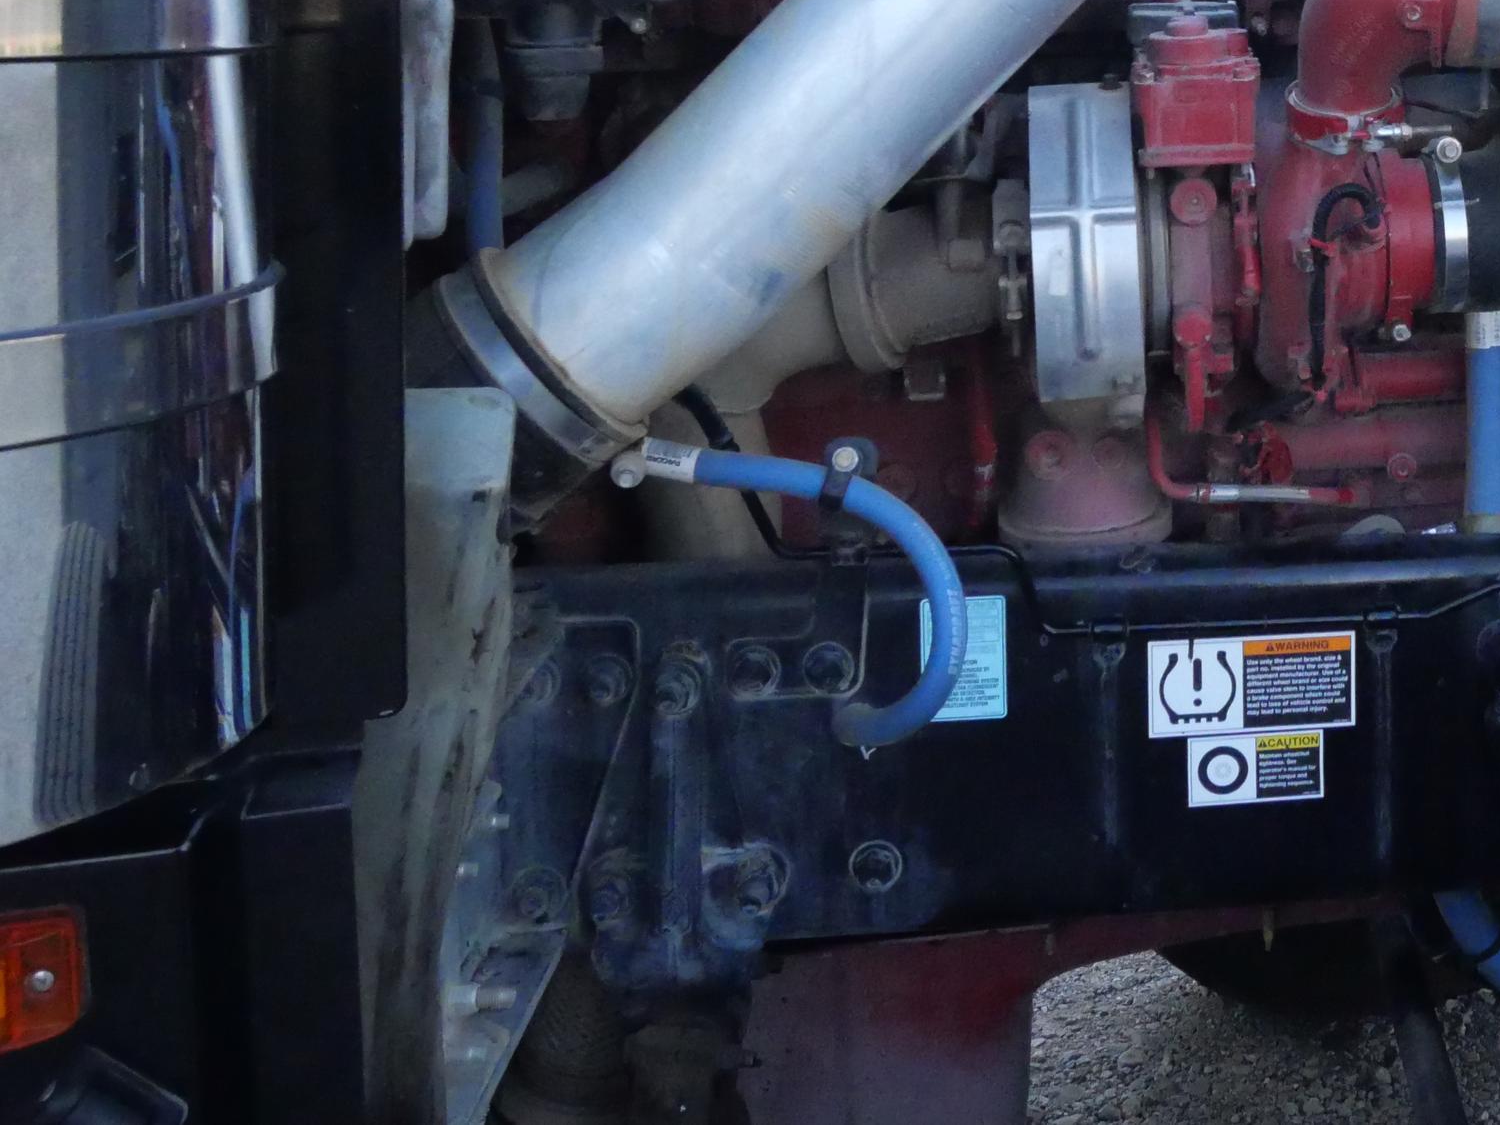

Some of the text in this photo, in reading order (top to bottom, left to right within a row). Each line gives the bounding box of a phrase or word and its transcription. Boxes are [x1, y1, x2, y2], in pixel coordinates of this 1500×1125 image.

[1276, 640, 1328, 651] WARNING
[1271, 664, 1296, 672] installed
[1268, 736, 1318, 747] CAUTION
